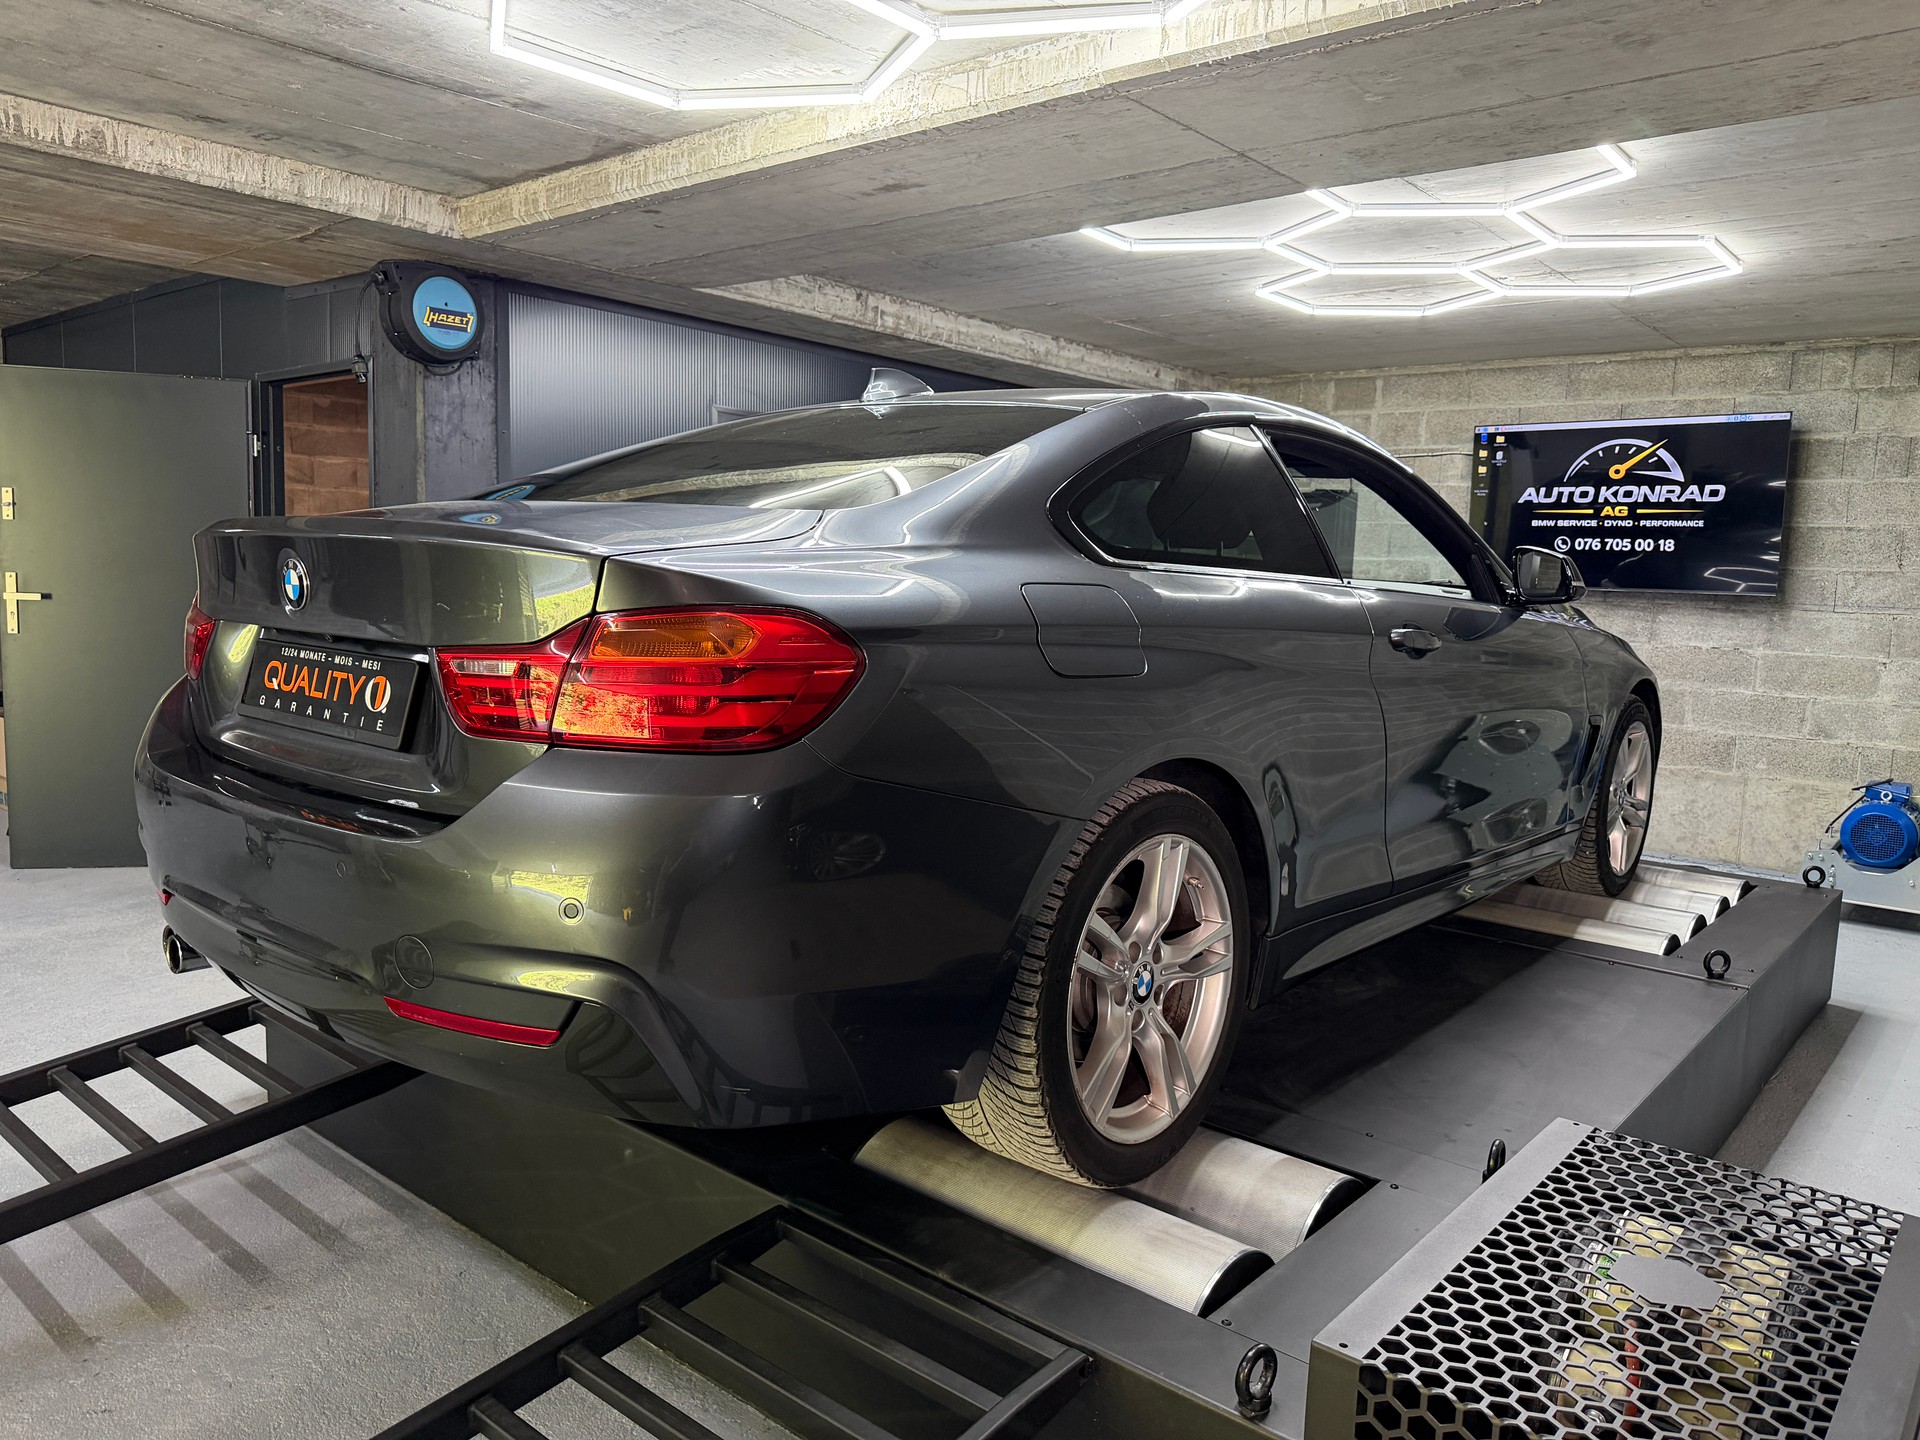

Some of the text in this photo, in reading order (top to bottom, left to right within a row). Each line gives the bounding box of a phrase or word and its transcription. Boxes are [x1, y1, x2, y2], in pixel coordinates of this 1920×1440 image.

[429, 311, 468, 325] HAZET
[1518, 485, 1726, 503] AUTO KONRAD
[1600, 506, 1628, 516] AG
[1575, 538, 1675, 551] 076 705 00 18
[281, 647, 298, 657] 12/24
[300, 650, 326, 662] MONATE
[334, 655, 353, 666] MOIS
[362, 659, 381, 670] MESI
[264, 660, 366, 705] QUALITY
[259, 695, 383, 731] GARANTIE
